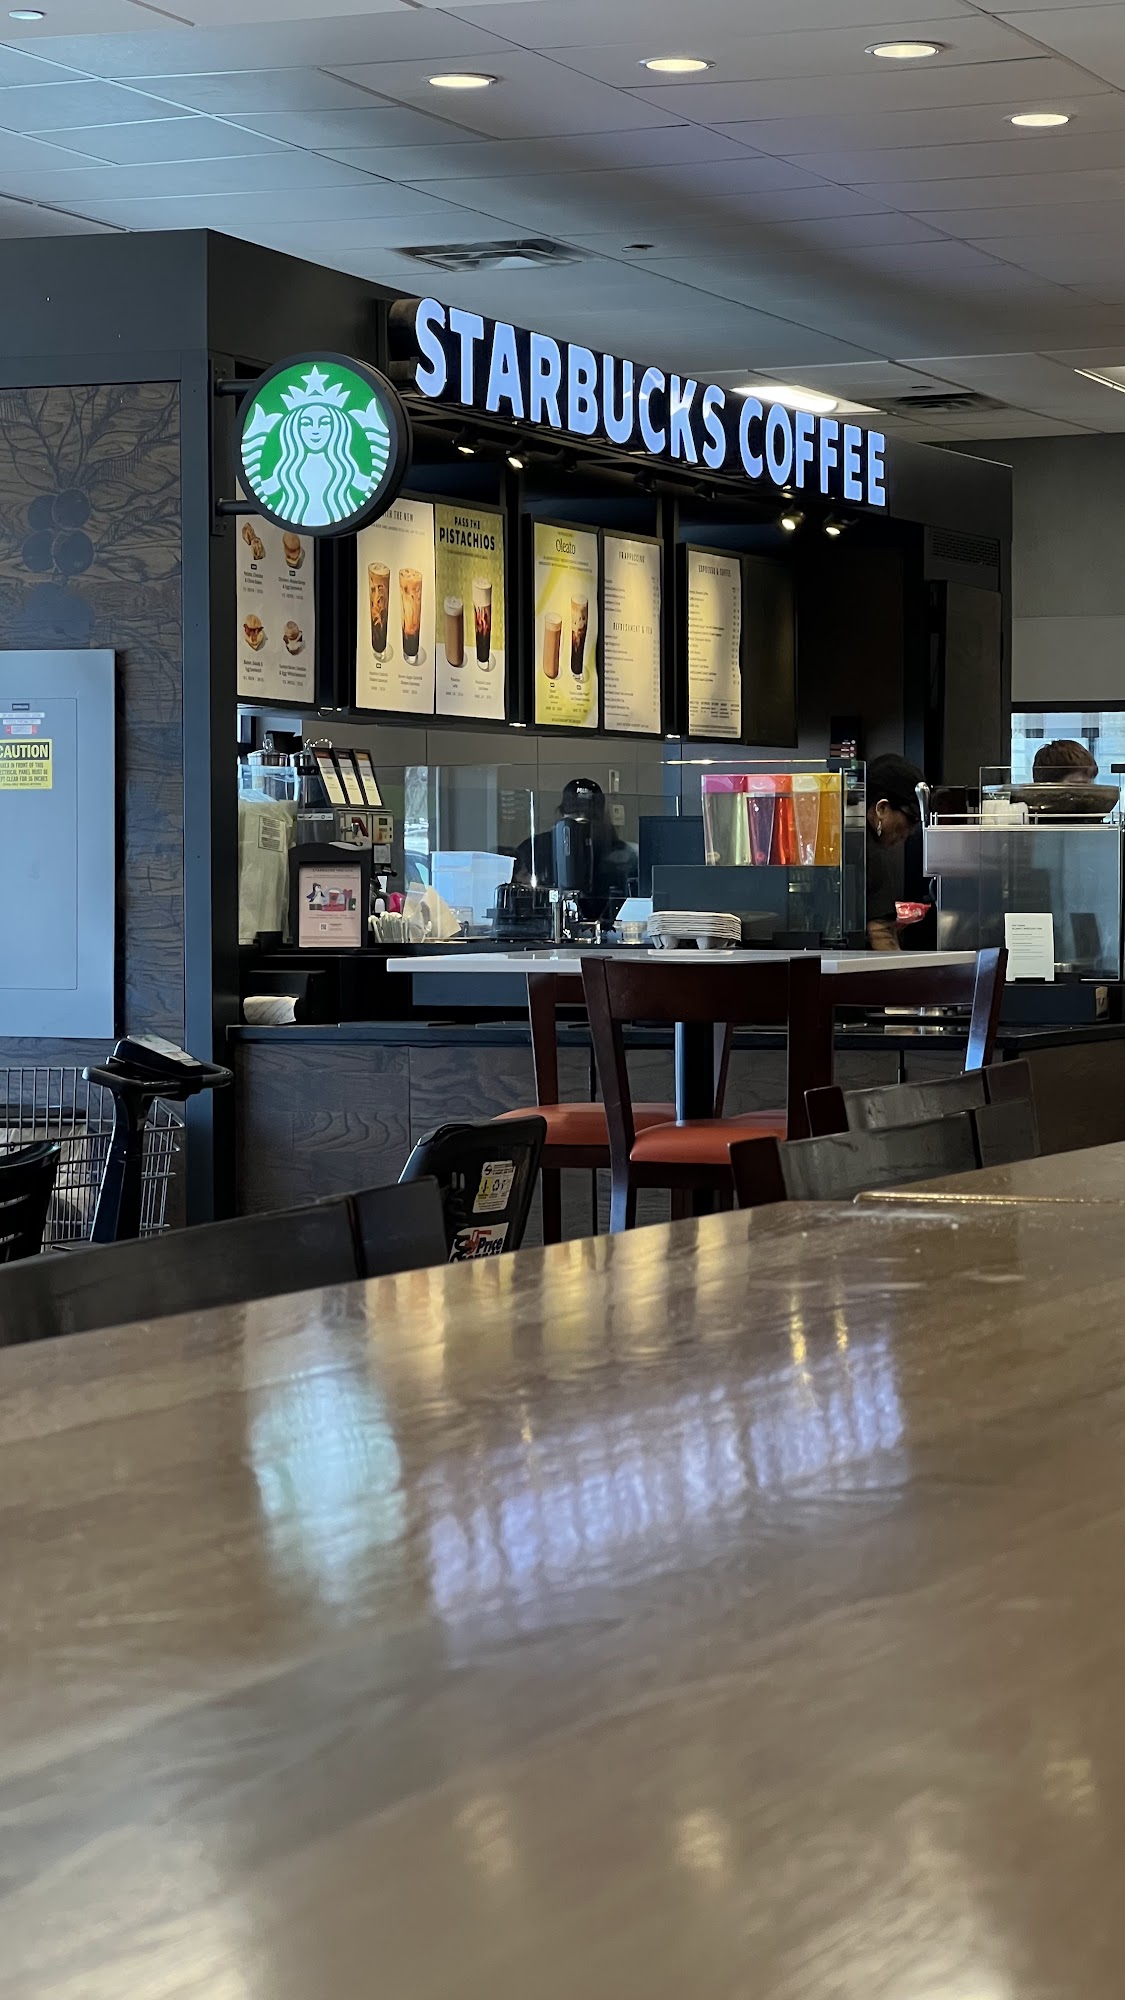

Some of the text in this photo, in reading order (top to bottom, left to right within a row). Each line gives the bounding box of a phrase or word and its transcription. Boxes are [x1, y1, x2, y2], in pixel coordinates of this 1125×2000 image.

[415, 297, 886, 507] STARBUCKS COFFEE
[394, 510, 402, 520] THE
[454, 516, 480, 530] PASS THE
[439, 527, 495, 551] PISTACHIOS
[555, 538, 576, 555] Oleato
